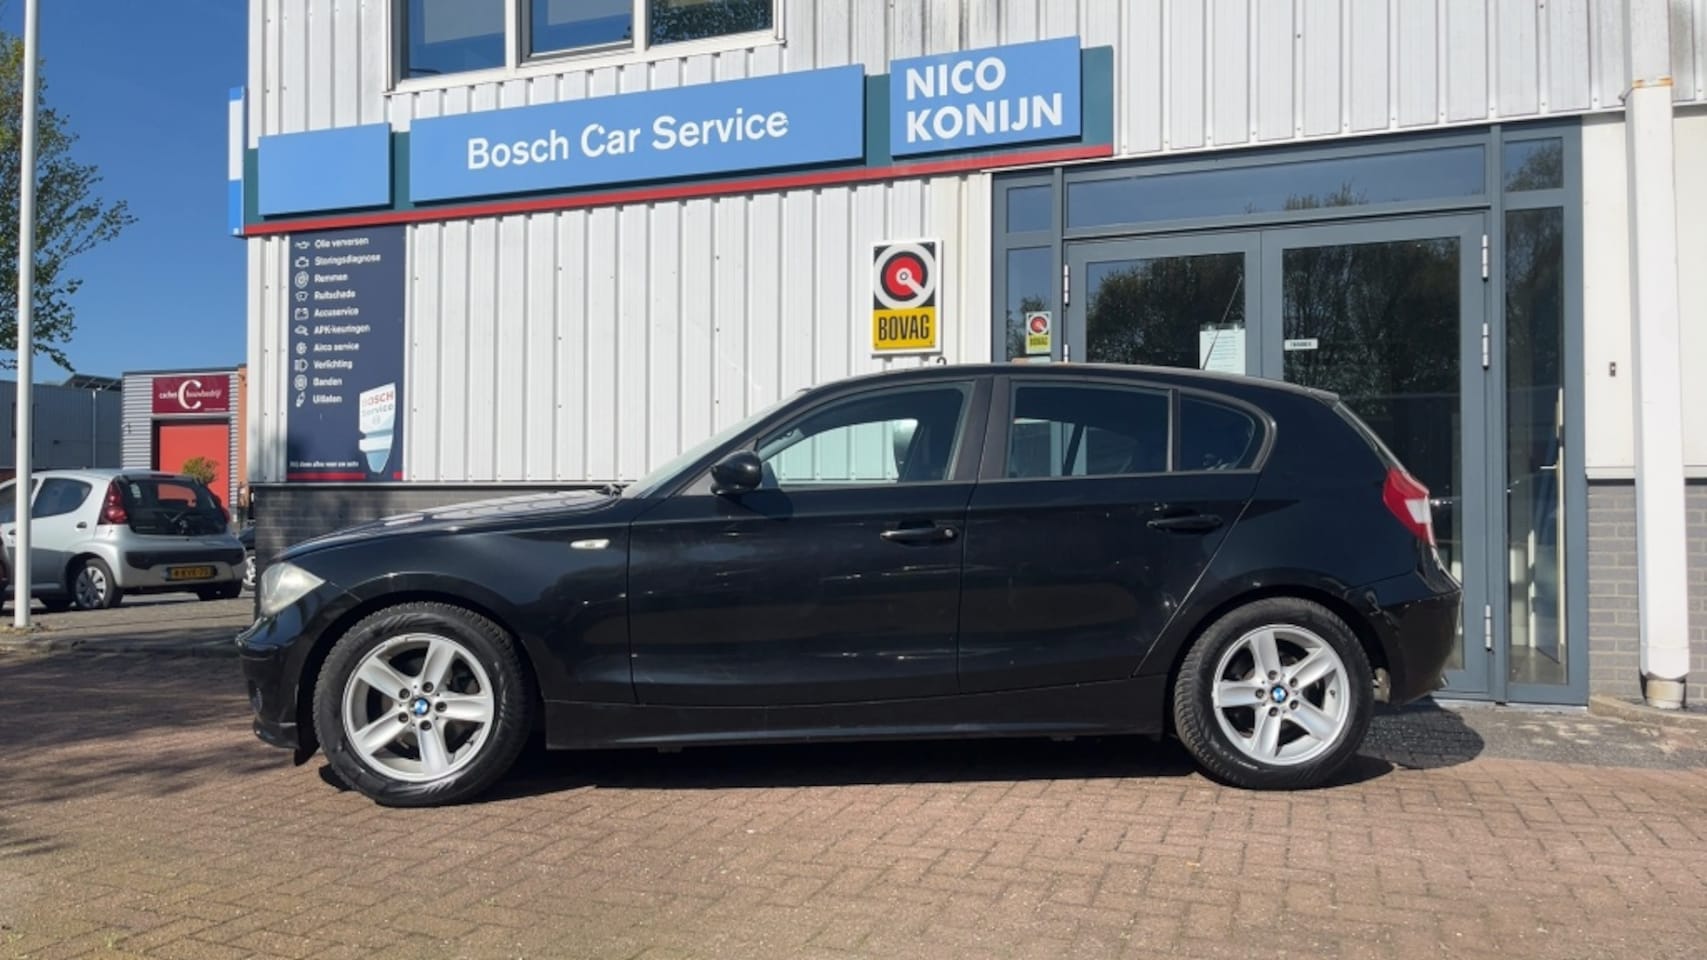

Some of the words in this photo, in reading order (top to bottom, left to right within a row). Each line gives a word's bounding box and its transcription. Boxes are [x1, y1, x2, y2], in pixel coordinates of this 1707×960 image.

[907, 58, 1006, 100] NICO
[908, 93, 1062, 143] KONIJN
[469, 130, 568, 169] Bosch
[582, 124, 640, 157] Car
[653, 109, 787, 149] Service
[314, 239, 330, 249] Olie
[314, 273, 348, 283] Remmen
[314, 307, 359, 318] Accuservice
[878, 314, 929, 341] BOVAG
[313, 343, 332, 352] Airco
[334, 342, 359, 351] service
[313, 358, 353, 370] Verlichting
[313, 377, 342, 386] Banden
